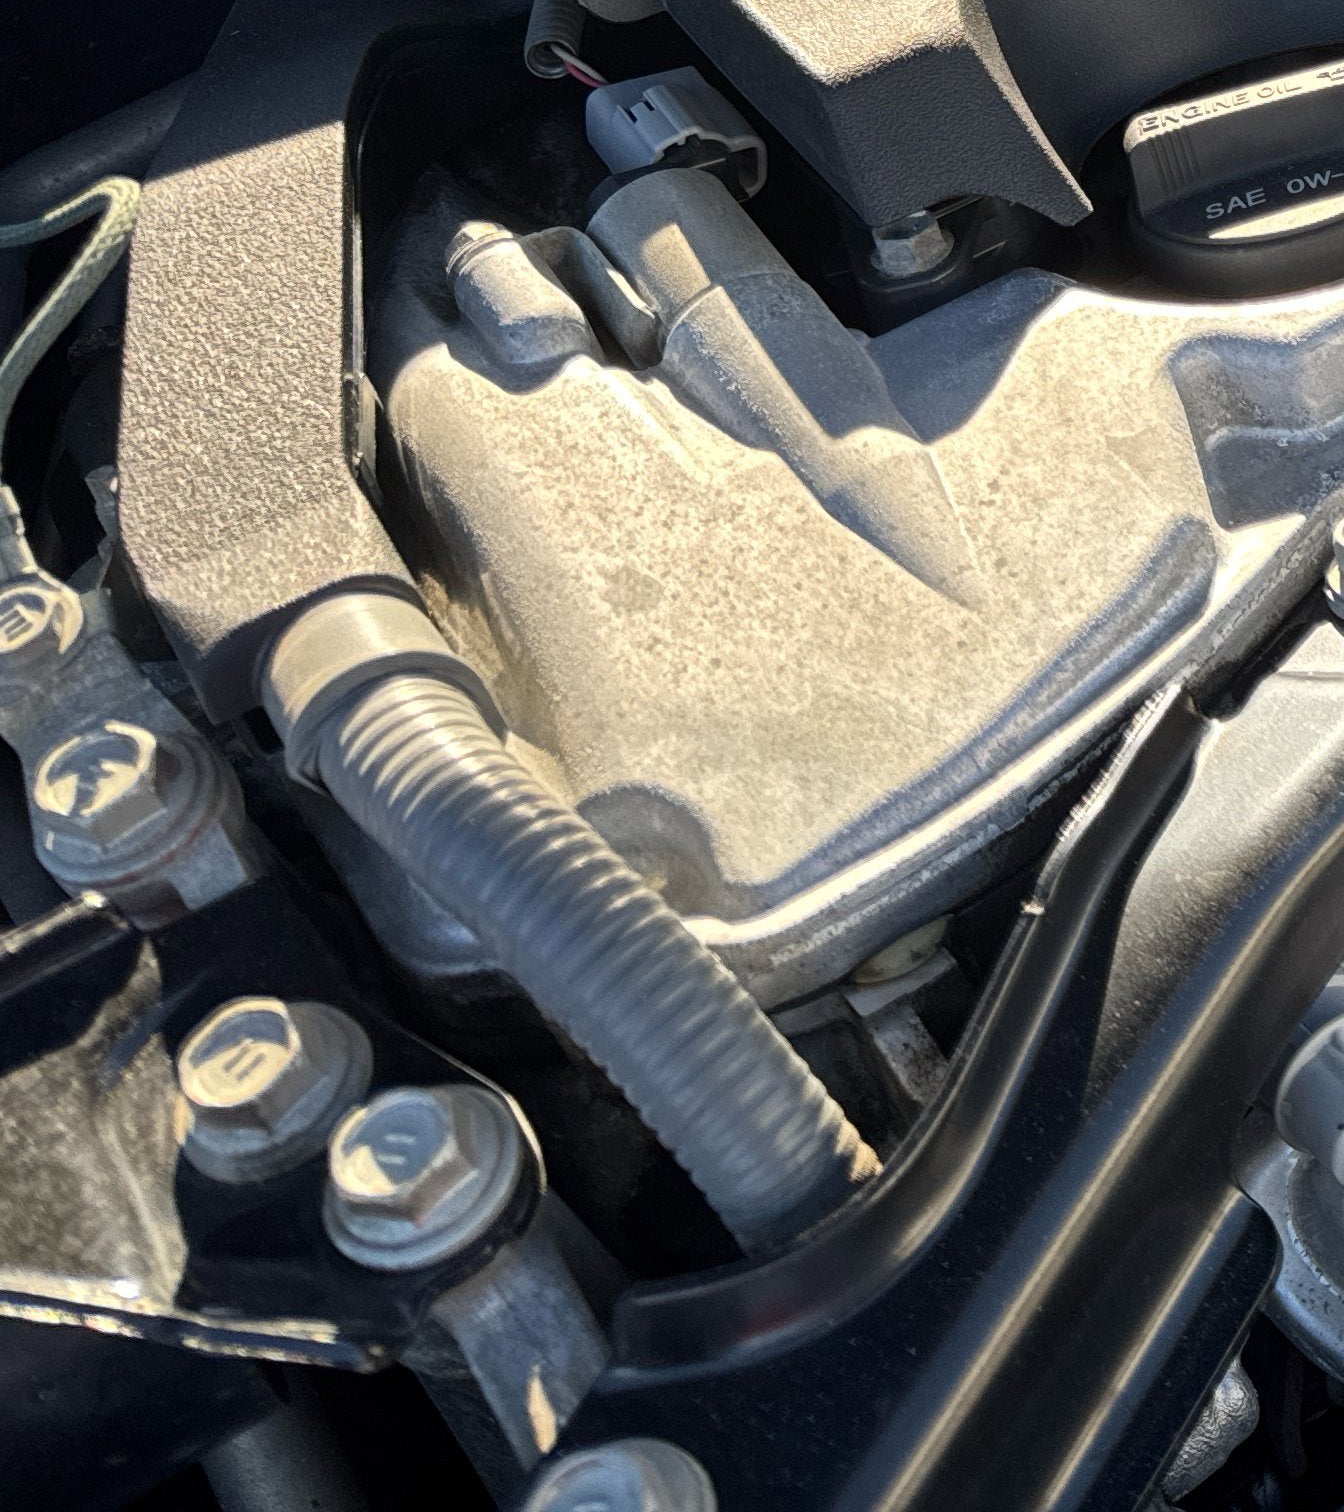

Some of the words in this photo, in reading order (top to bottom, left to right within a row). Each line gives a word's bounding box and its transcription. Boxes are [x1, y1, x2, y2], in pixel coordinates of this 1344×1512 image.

[1138, 90, 1251, 137] ENGINE
[1256, 80, 1303, 99] OIL
[1205, 187, 1268, 220] SAE
